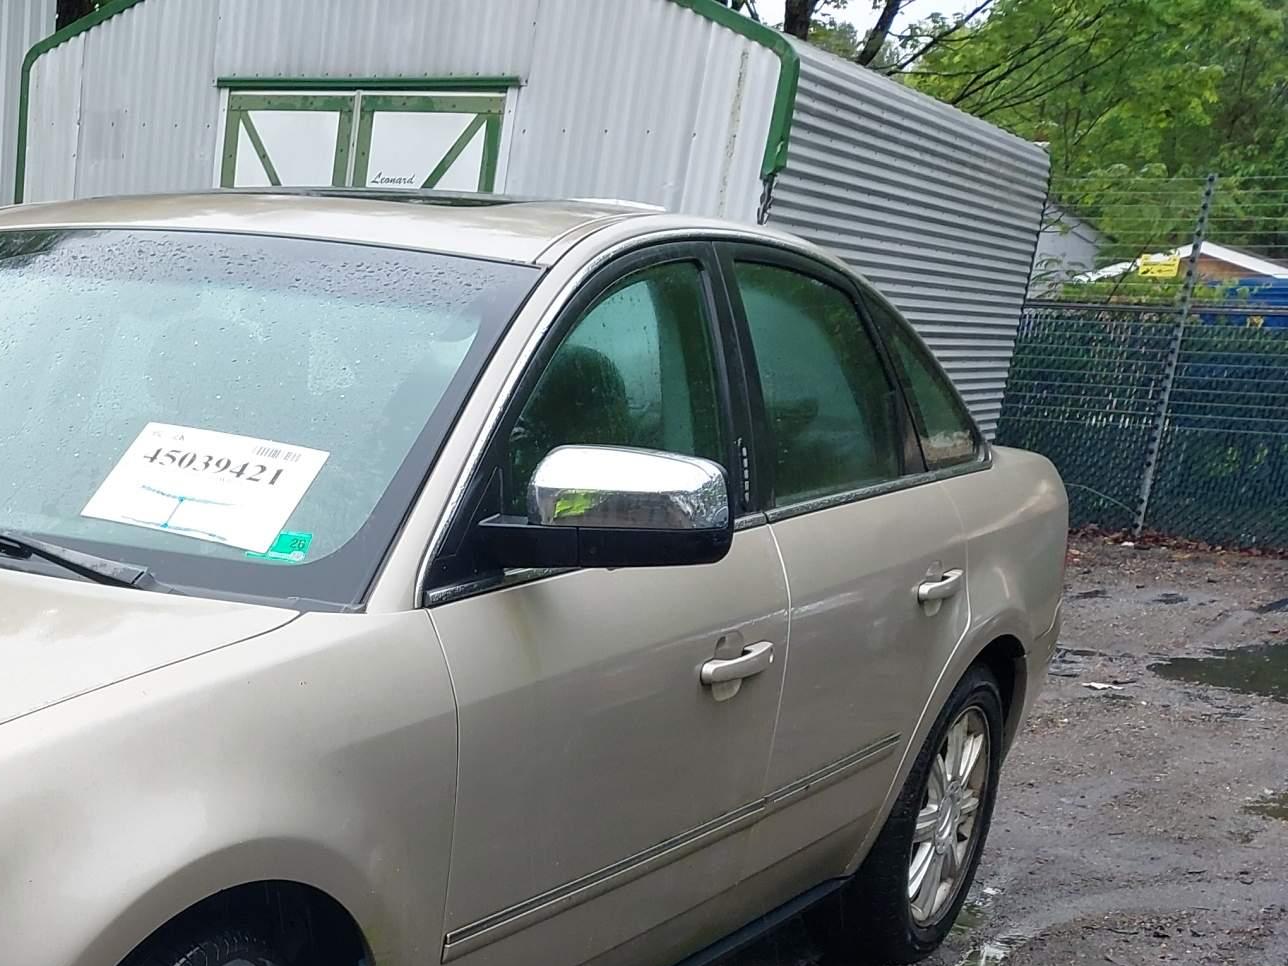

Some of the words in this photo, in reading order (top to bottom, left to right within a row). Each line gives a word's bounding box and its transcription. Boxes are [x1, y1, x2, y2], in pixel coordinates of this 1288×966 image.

[370, 170, 416, 185] Leonard
[143, 447, 284, 486] 45039421
[289, 537, 307, 550] 26
